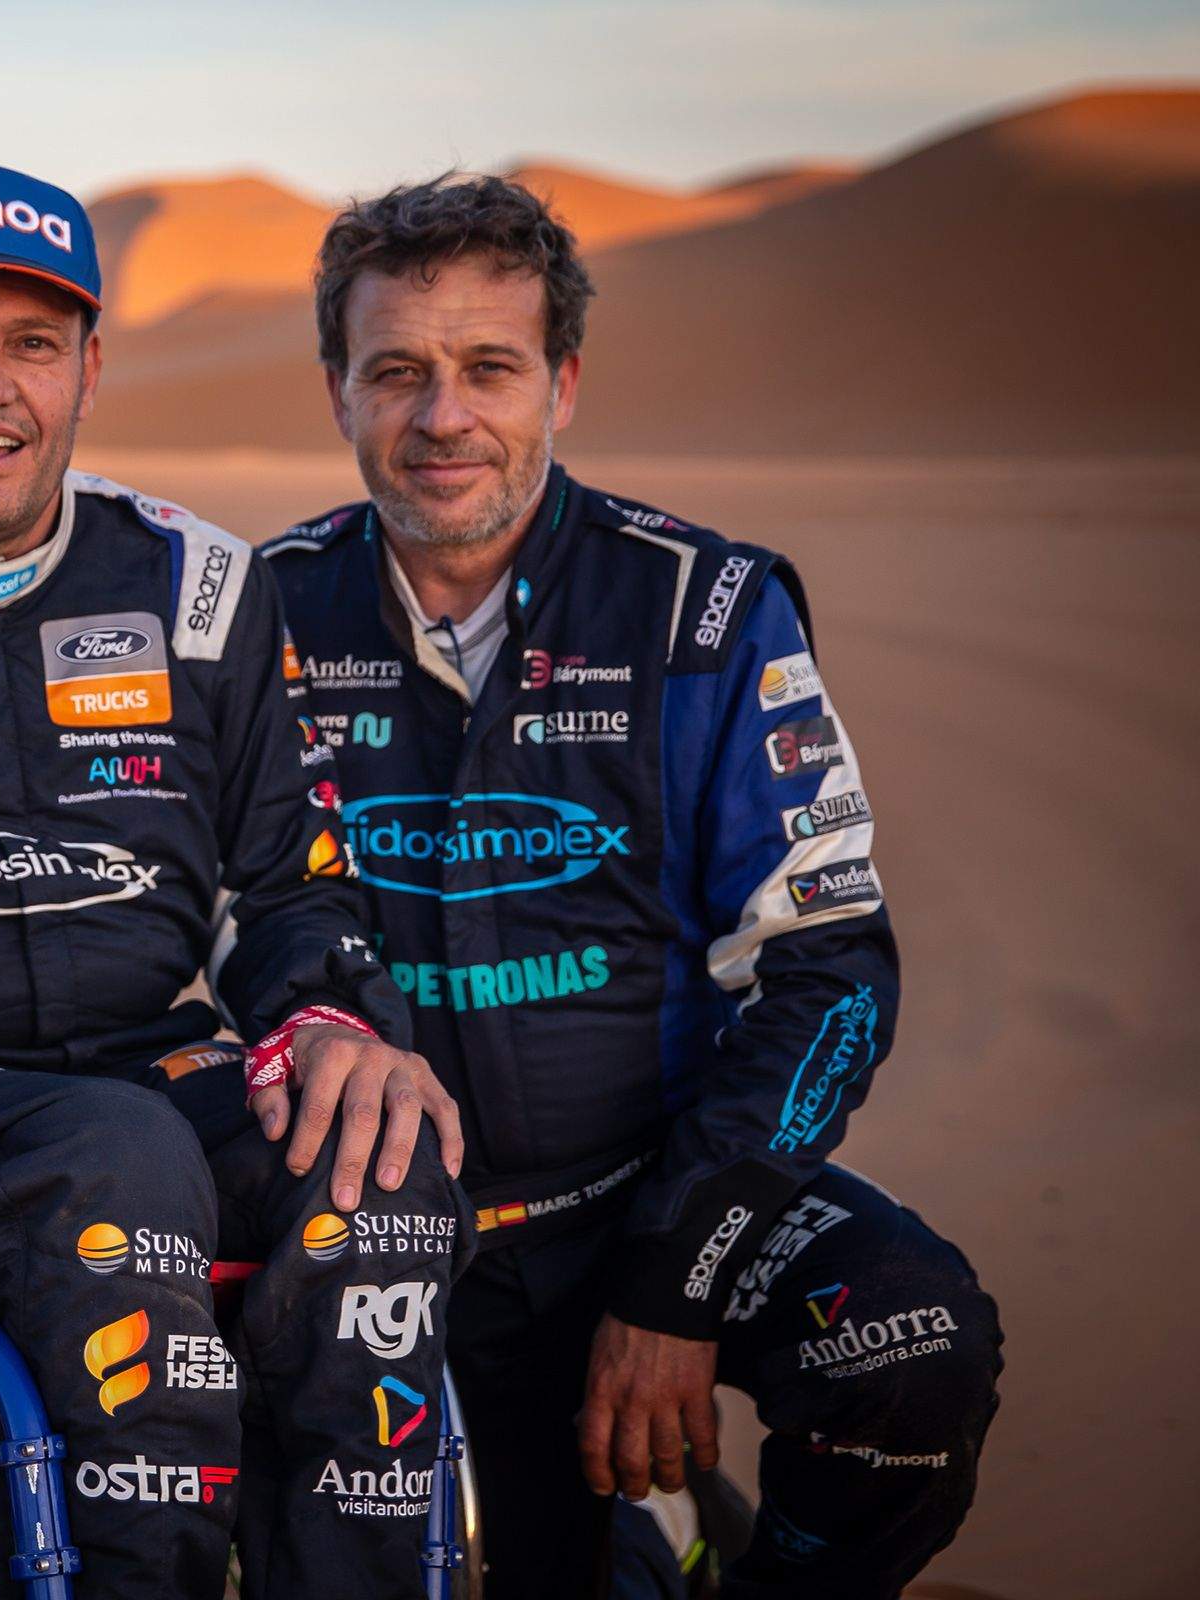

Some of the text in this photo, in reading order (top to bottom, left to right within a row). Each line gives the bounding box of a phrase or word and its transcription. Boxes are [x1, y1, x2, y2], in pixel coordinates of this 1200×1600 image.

[188, 545, 231, 635] sparco
[695, 556, 755, 649] sparco
[74, 632, 134, 659] Ford
[301, 653, 403, 678] Andorra
[70, 689, 148, 714] TRUCKS
[546, 709, 629, 734] surne
[60, 732, 119, 748] Sharing
[120, 731, 144, 744] the
[390, 945, 610, 1013] PETRONAS
[527, 1190, 581, 1217] MARC
[354, 1211, 456, 1237] SUNRISE
[684, 1205, 753, 1301] sparco
[136, 1258, 206, 1279] MEDIC
[799, 1305, 959, 1369] Andorra
[76, 1454, 201, 1503] ostra
